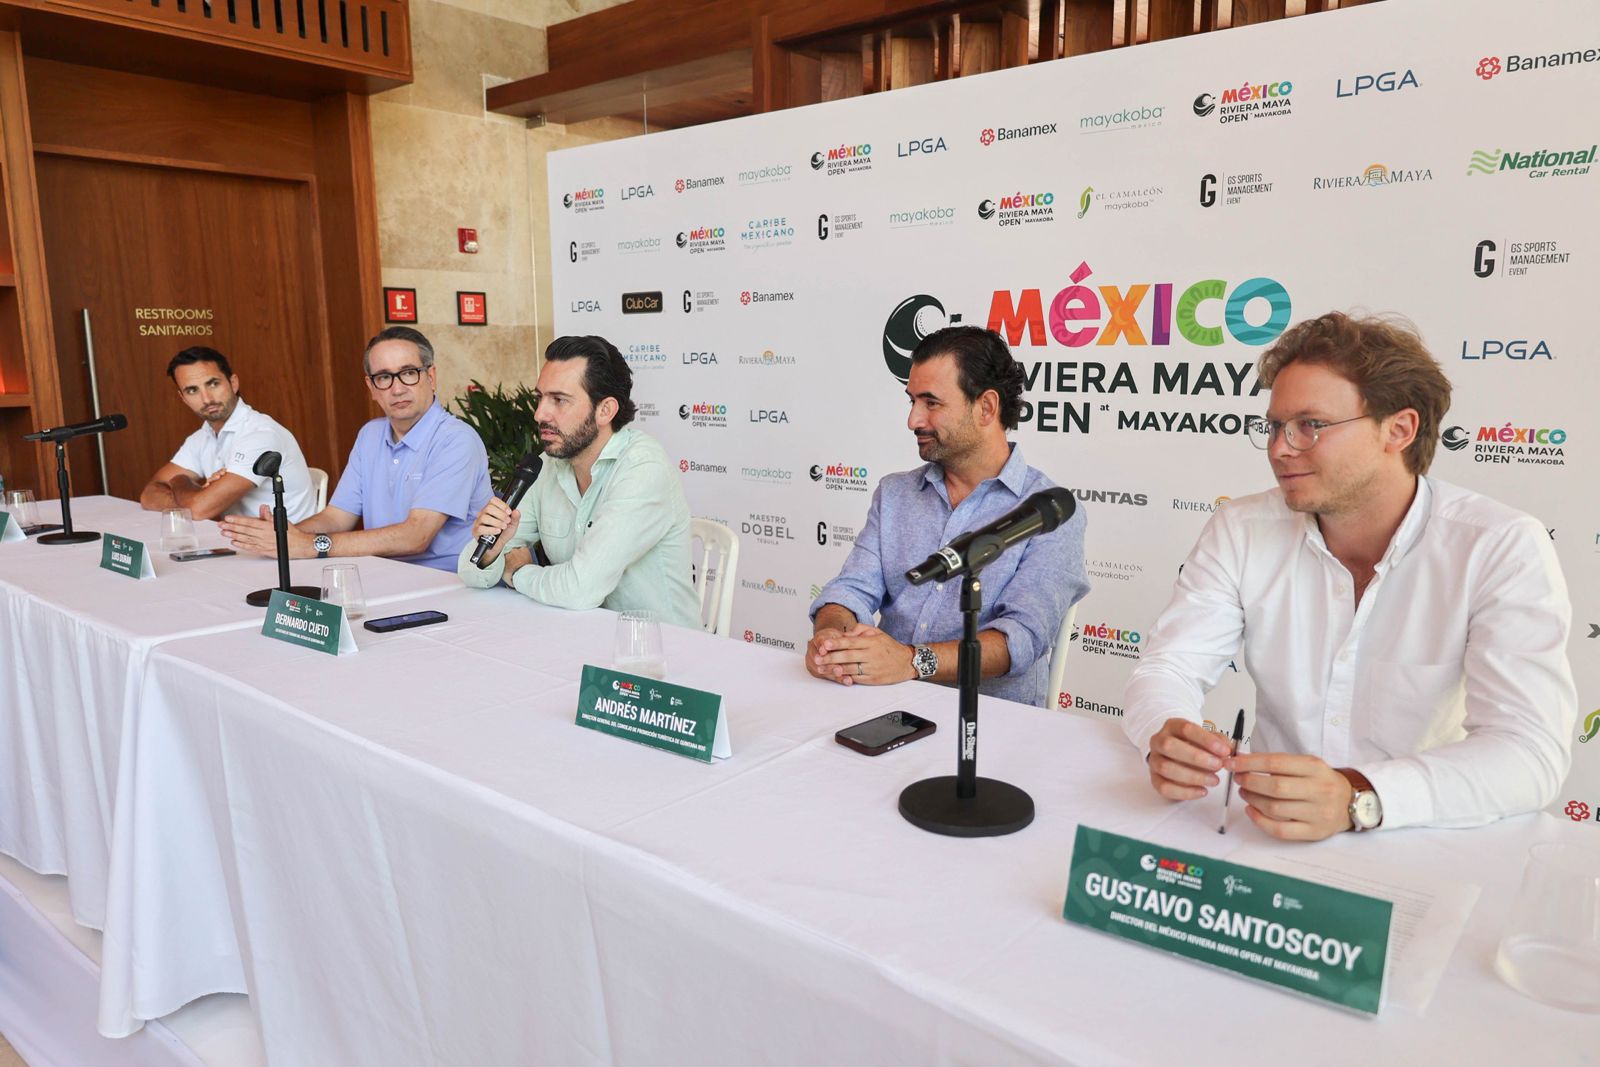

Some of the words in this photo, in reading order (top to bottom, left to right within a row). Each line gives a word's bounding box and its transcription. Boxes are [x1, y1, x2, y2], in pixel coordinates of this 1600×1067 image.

[1336, 69, 1419, 98] LPGA
[1220, 102, 1259, 115] RIVIERA
[1262, 98, 1291, 110] MAYA
[1080, 106, 1162, 128] mayakoba
[1220, 113, 1248, 124] OPEN
[998, 122, 1057, 141] Banamex
[897, 136, 948, 158] LPGA
[827, 160, 852, 169] RIVIERA
[853, 157, 871, 165] MAYA
[1499, 145, 1597, 171] National
[738, 165, 791, 181] mayakoba
[827, 168, 846, 176] OPEN
[1227, 175, 1236, 185] GS
[1238, 173, 1263, 184] SPORTS
[1313, 176, 1361, 190] RIVIERA
[1391, 168, 1433, 183] MAYA
[1529, 169, 1548, 179] Car
[1551, 166, 1590, 177] Rental
[686, 176, 725, 190] Banamex
[1227, 182, 1273, 195] MANAGEMENT
[621, 184, 654, 201] LPGA
[1199, 173, 1217, 208] G
[1104, 200, 1149, 211] mayakoba
[1226, 196, 1241, 205] EVENT
[889, 207, 955, 224] mayakoba
[999, 210, 1029, 219] RIVIERA
[1030, 207, 1054, 216] MAYA
[748, 218, 787, 230] CARIBE
[818, 213, 828, 240] G
[999, 218, 1021, 227] OPEN
[741, 227, 795, 240] MEXICANO
[617, 237, 661, 250] mayakoba
[1511, 243, 1523, 253] GS
[1524, 241, 1557, 253] SPORTS
[1474, 240, 1497, 278] G
[1510, 253, 1570, 266] MANAGEMENT
[1509, 267, 1528, 276] EVENT
[625, 297, 644, 309] Club
[644, 296, 659, 308] Car
[752, 290, 794, 303] Banamex
[571, 300, 602, 313] LPGA
[987, 261, 1292, 348] México
[135, 308, 214, 320] RESTROOMS
[139, 325, 214, 336] SANITARIOS
[1461, 340, 1553, 360] LPGA
[682, 352, 718, 365] LPGA
[738, 355, 764, 365] RIVIERA
[775, 355, 796, 365] MAYA
[1016, 361, 1138, 394] VIERA
[750, 410, 789, 424] LPGA
[1012, 401, 1091, 434] PEN
[1100, 403, 1110, 411] at
[1475, 444, 1524, 455] RIVIERA
[1528, 446, 1564, 458] MAYA
[1475, 454, 1510, 464] OPEN
[1517, 457, 1565, 466] MAYAKOBA
[690, 461, 728, 474] Banamex
[741, 466, 792, 480] mayakoba
[825, 477, 849, 485] RIVIERA
[1172, 498, 1213, 513] RIVIERA
[749, 513, 787, 525] MAESTRO
[741, 522, 795, 540] DOBEL
[817, 521, 827, 546] G
[1087, 569, 1130, 581] mayakoba
[741, 579, 765, 589] RIVIERA
[777, 586, 797, 597] MAYA
[275, 612, 308, 631] BERNARDO
[308, 621, 330, 637] CUETO
[755, 633, 796, 650] Banamex
[1082, 637, 1114, 649] RIVIERA
[1116, 642, 1140, 653] MAYA
[1082, 645, 1106, 655] OPEN
[1075, 696, 1124, 718] Banam
[594, 696, 638, 721] ANDRÉS
[639, 708, 697, 736] MARTÍNEZ
[1084, 871, 1194, 923] GUSTAVO
[1197, 903, 1363, 971] SANTOSCOY
[1109, 910, 1145, 929] DIRECTOR
[1144, 920, 1159, 933] DEL
[1158, 925, 1188, 942] MÉXICO
[1187, 933, 1217, 950] RIVIERA
[1217, 942, 1240, 958] MAYA
[1239, 949, 1264, 964] OPEN
[1262, 956, 1274, 967] AT
[1273, 959, 1320, 981] MAYAKOBA
